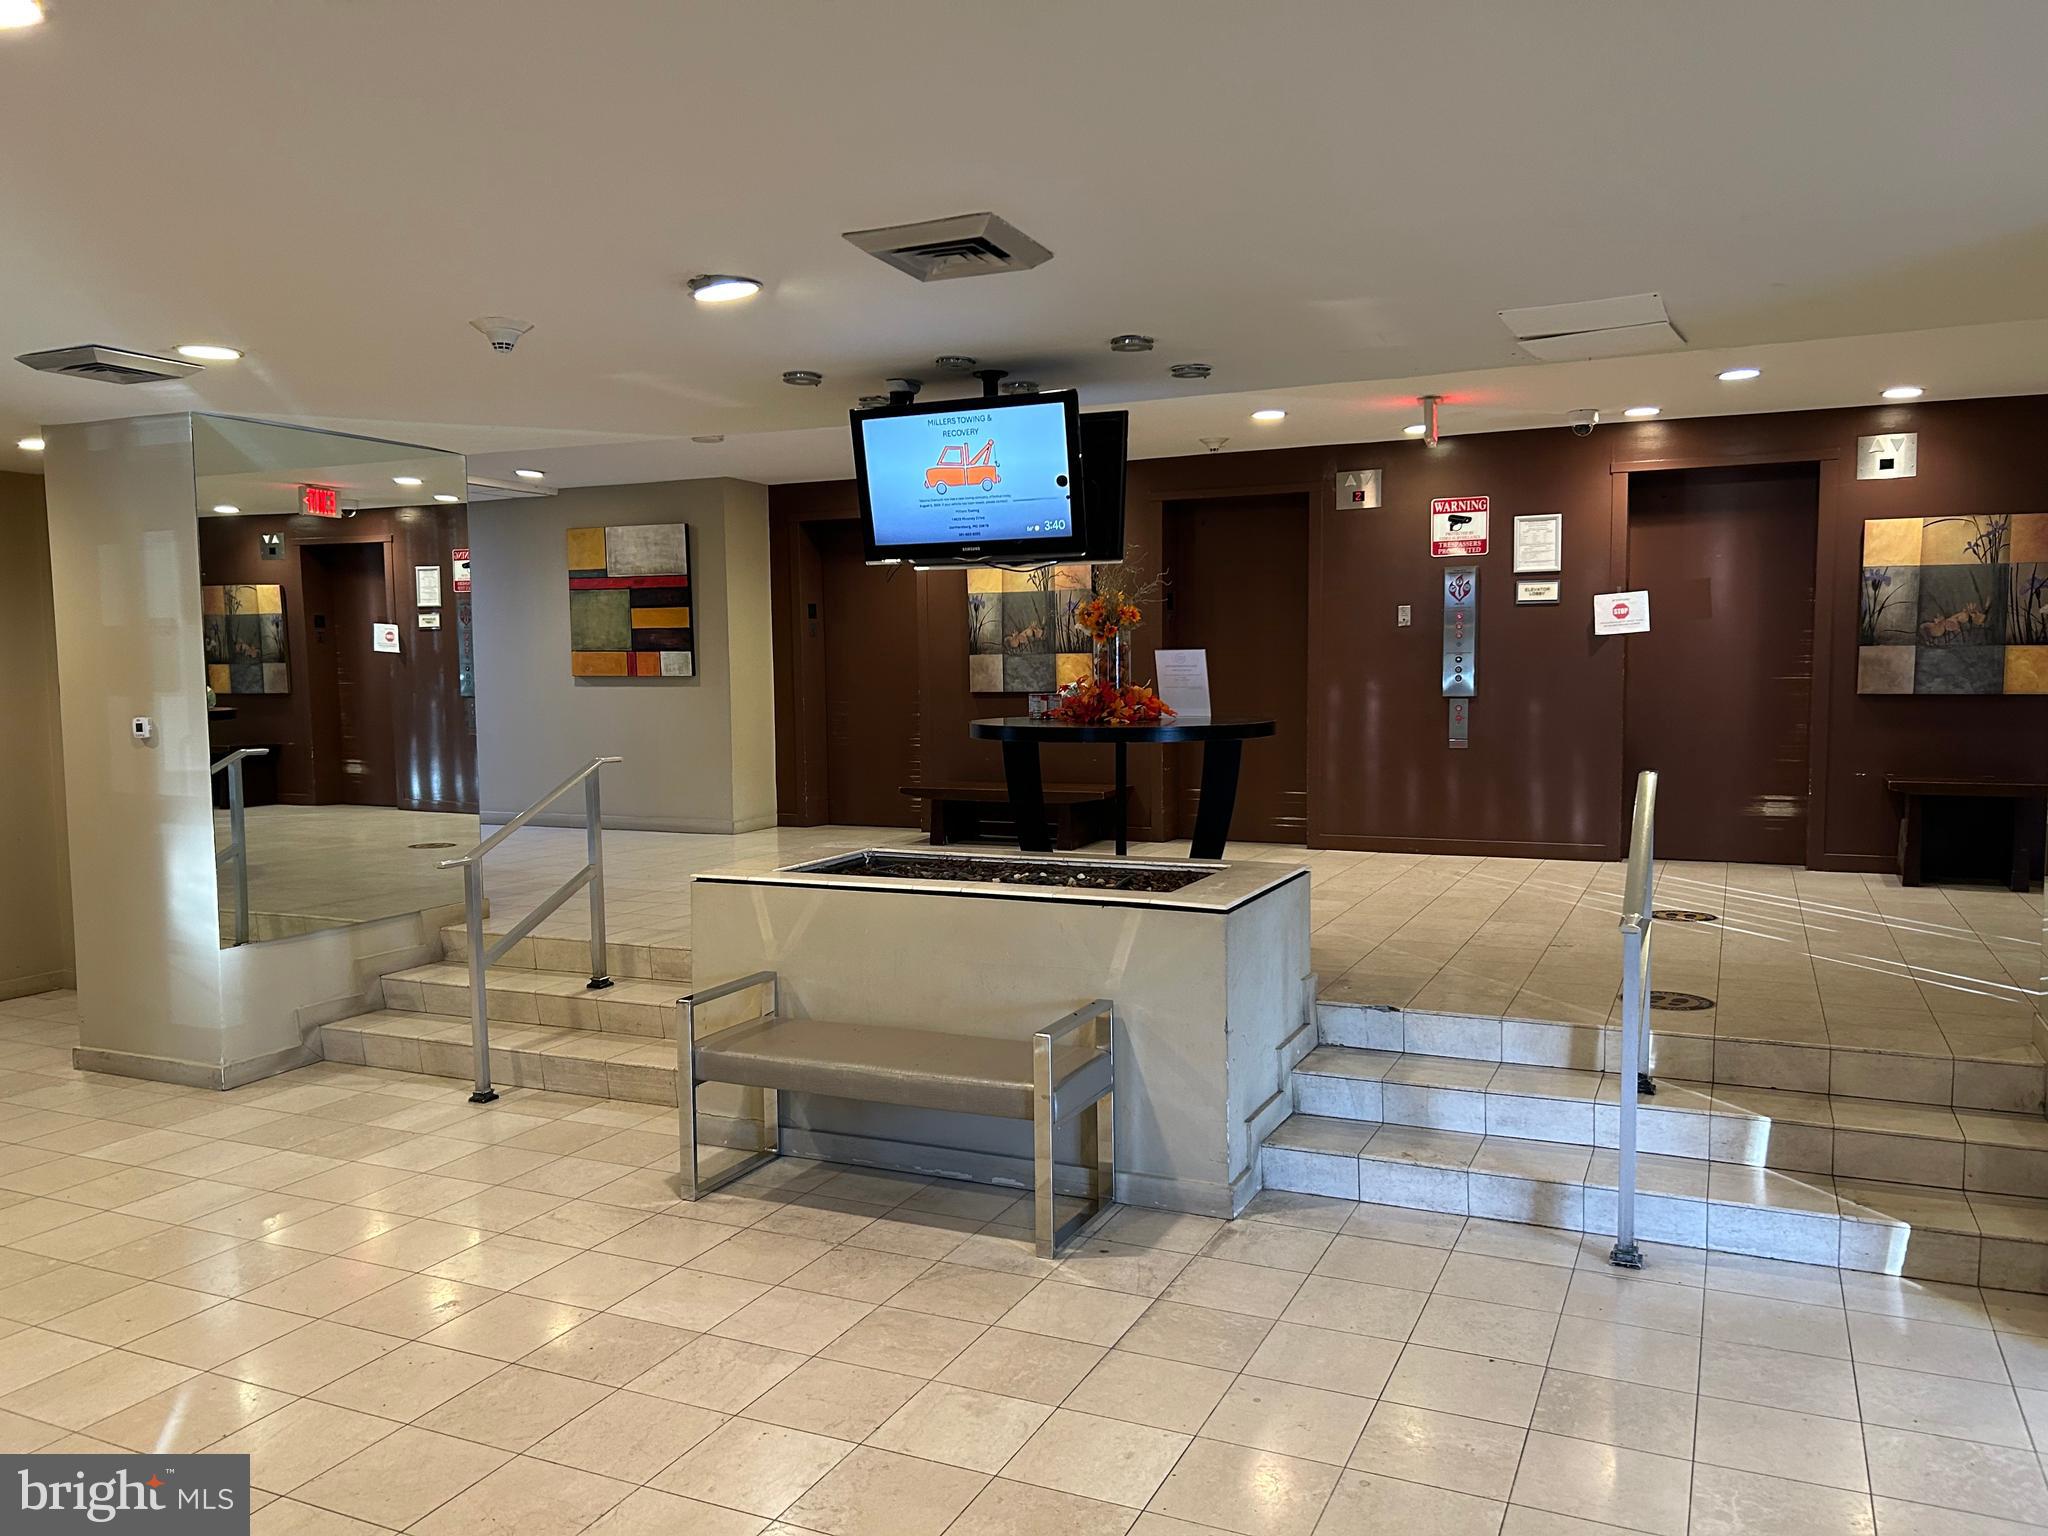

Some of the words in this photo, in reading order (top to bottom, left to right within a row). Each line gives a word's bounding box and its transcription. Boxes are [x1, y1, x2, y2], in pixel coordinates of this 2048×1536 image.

[927, 417, 956, 427] MILLERS
[957, 415, 986, 424] TOWING
[987, 414, 992, 422] &
[942, 428, 979, 438] RECOVERY
[1355, 492, 1362, 501] 2
[1434, 499, 1487, 513] WARNING
[1044, 519, 1066, 531] 3:40
[1437, 547, 1482, 555] PROUTED
[1613, 607, 1629, 615] STOP
